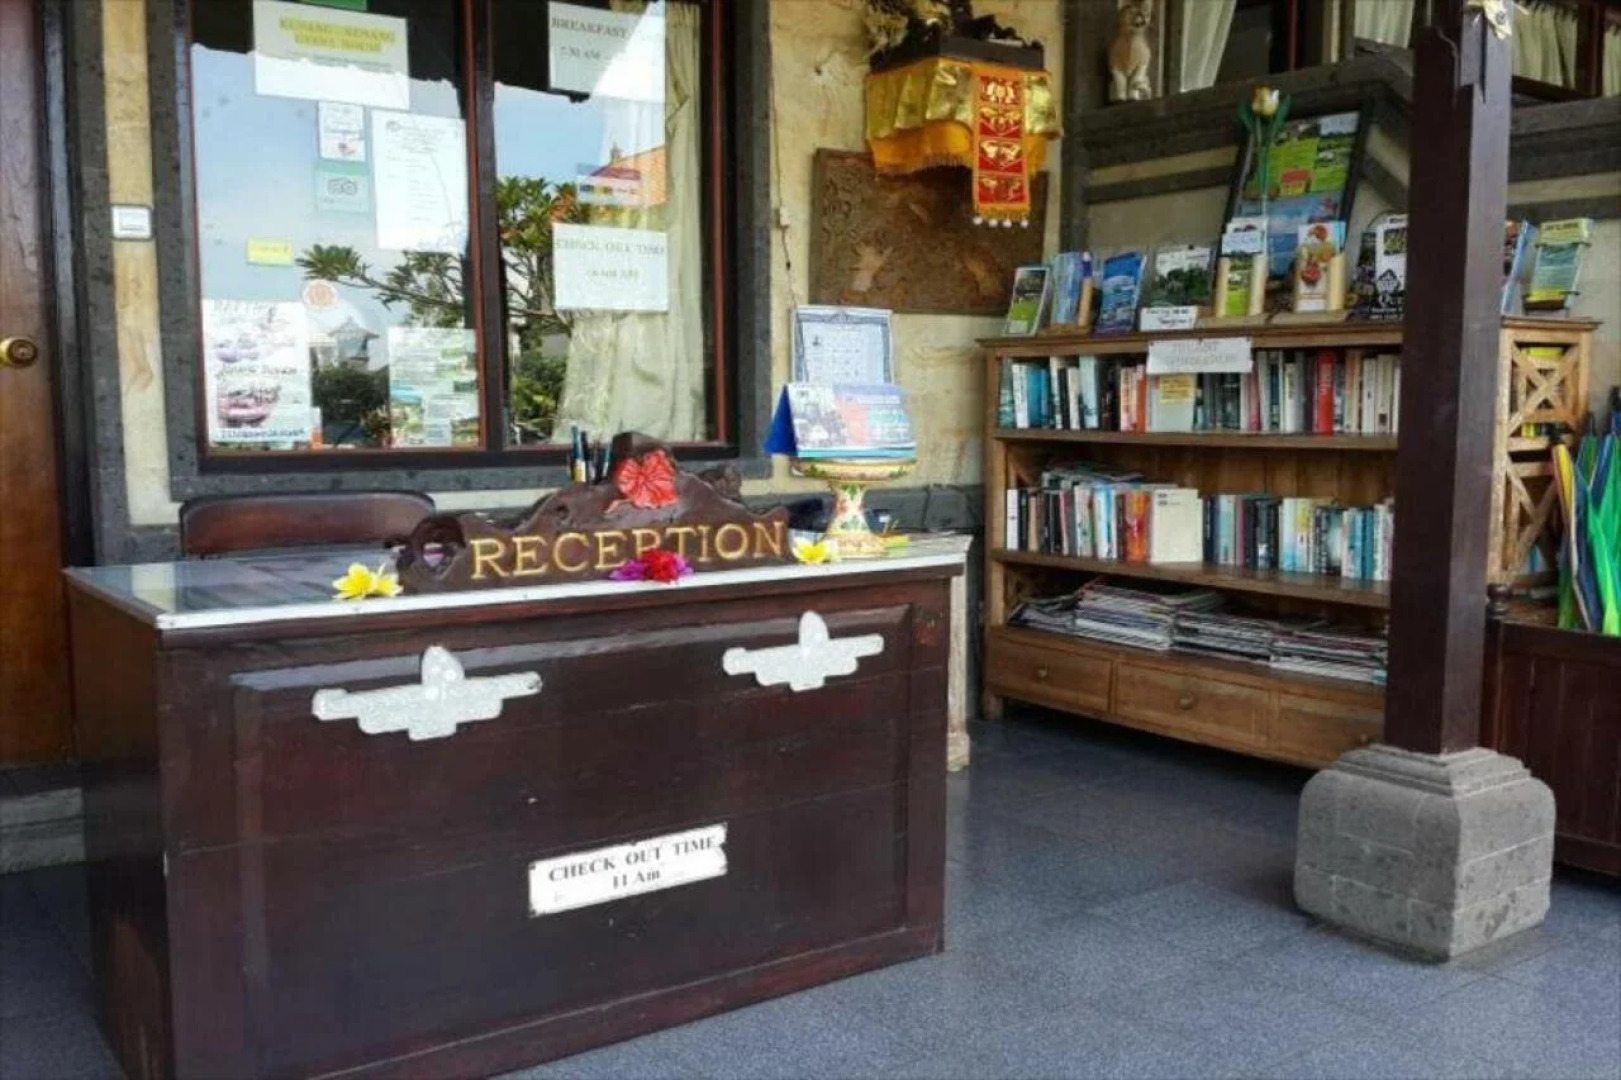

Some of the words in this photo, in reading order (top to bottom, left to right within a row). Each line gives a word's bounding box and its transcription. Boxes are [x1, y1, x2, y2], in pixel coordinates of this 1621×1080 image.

[551, 17, 626, 38] BREAKFAST
[469, 521, 785, 580] RECEPTION
[549, 857, 616, 883] CHECK
[625, 847, 662, 866] OUT
[672, 837, 714, 857] TIME
[612, 874, 628, 890] 11
